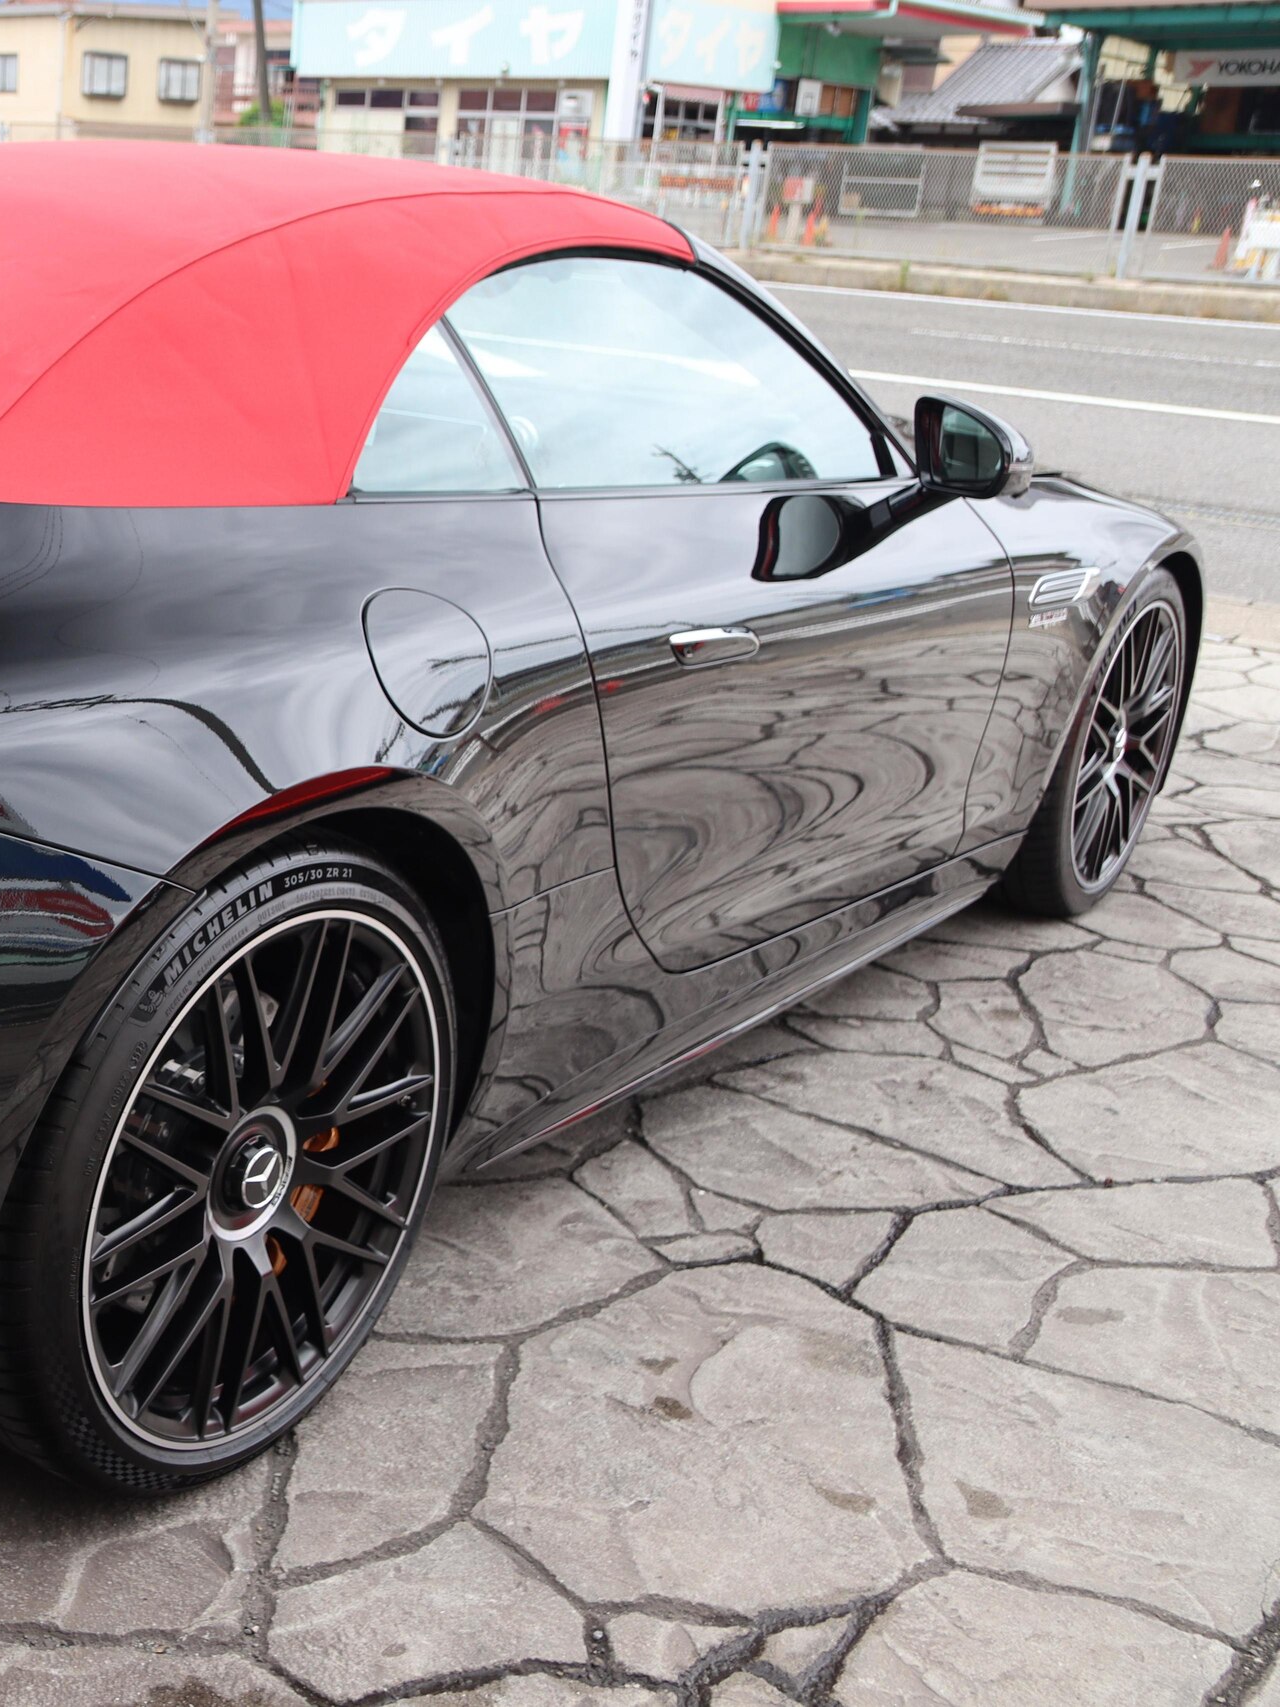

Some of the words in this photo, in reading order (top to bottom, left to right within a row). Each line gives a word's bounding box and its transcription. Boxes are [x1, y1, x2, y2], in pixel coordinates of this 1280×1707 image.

[347, 7, 584, 67] タイヤ
[658, 8, 767, 77] タイヤ
[284, 868, 323, 888] 305/30
[326, 867, 340, 878] ZR
[342, 867, 353, 878] 21
[163, 880, 274, 987] MICHELIN
